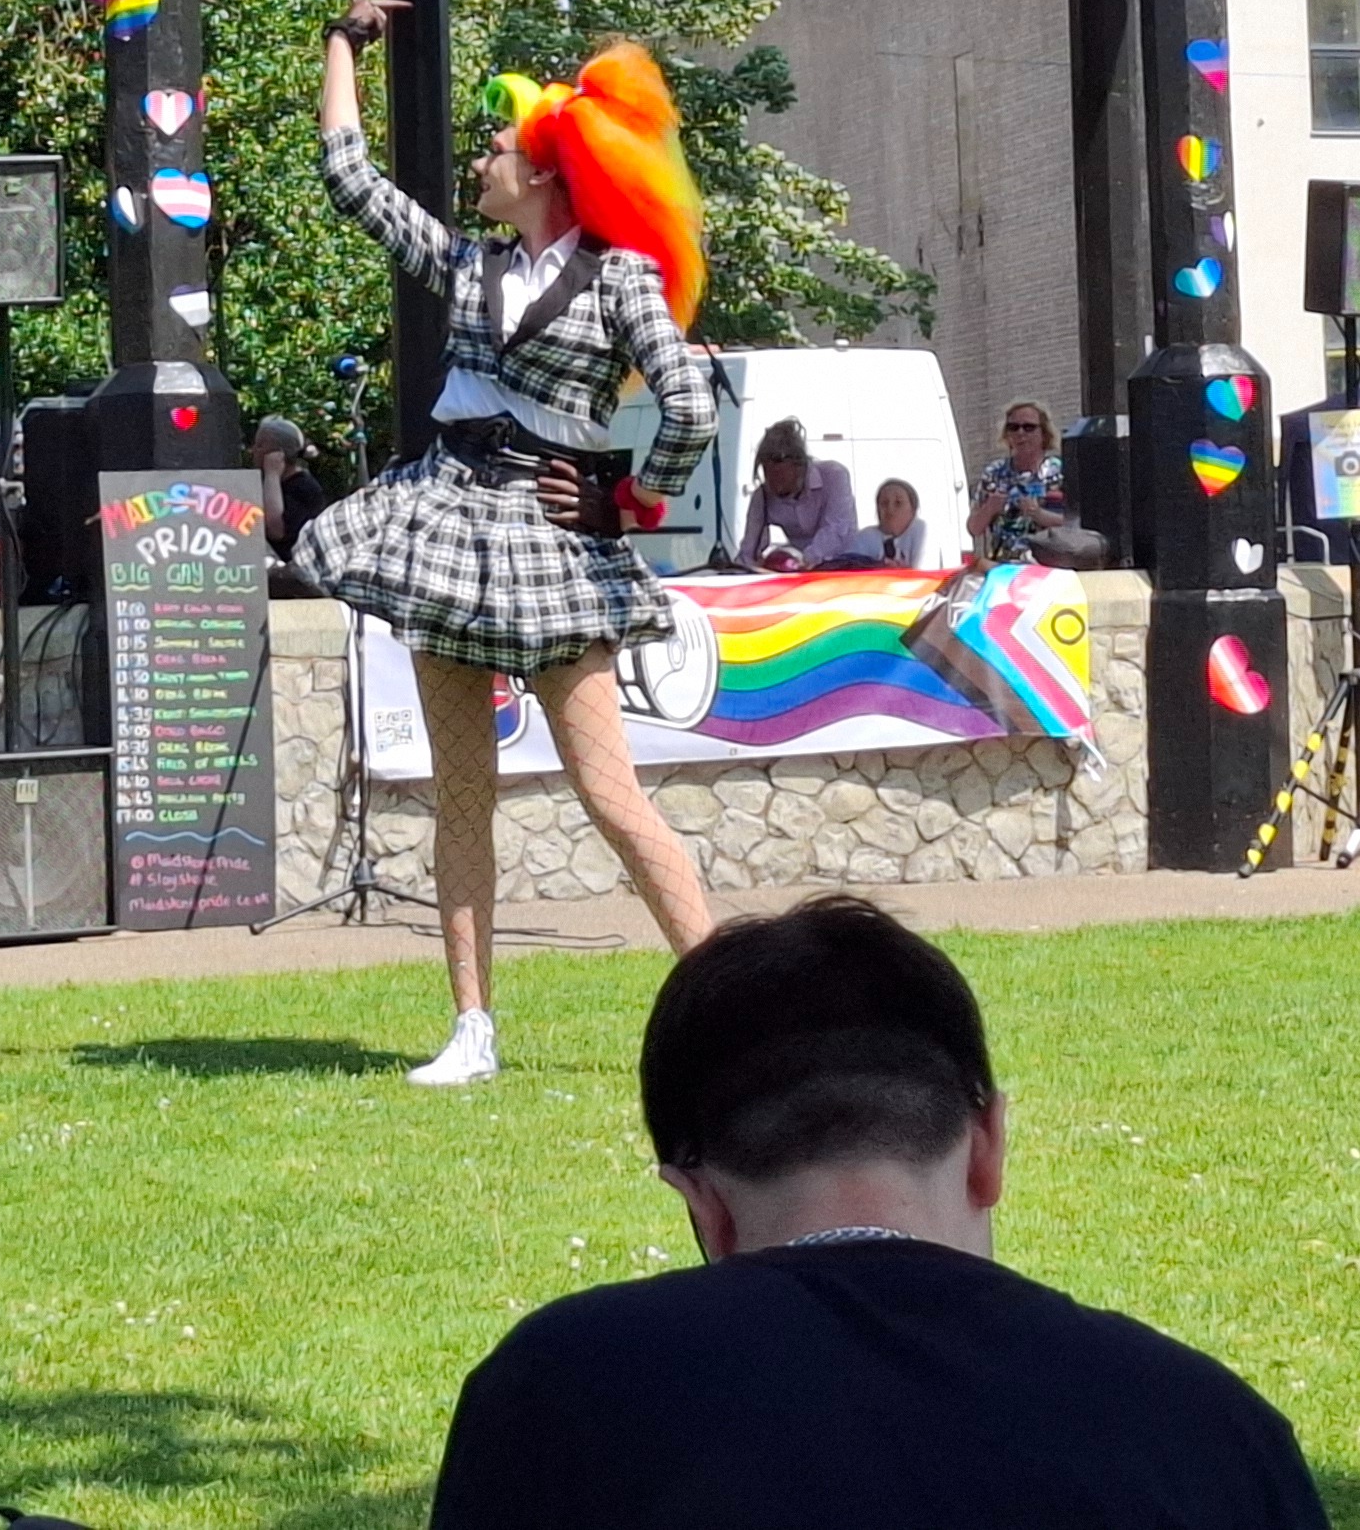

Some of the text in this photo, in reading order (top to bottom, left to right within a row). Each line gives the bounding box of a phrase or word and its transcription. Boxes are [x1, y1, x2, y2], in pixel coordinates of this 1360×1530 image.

[101, 482, 264, 539] MAIDSTONE
[136, 523, 237, 565] PRIDE
[110, 562, 256, 585] BIG GAY OUT
